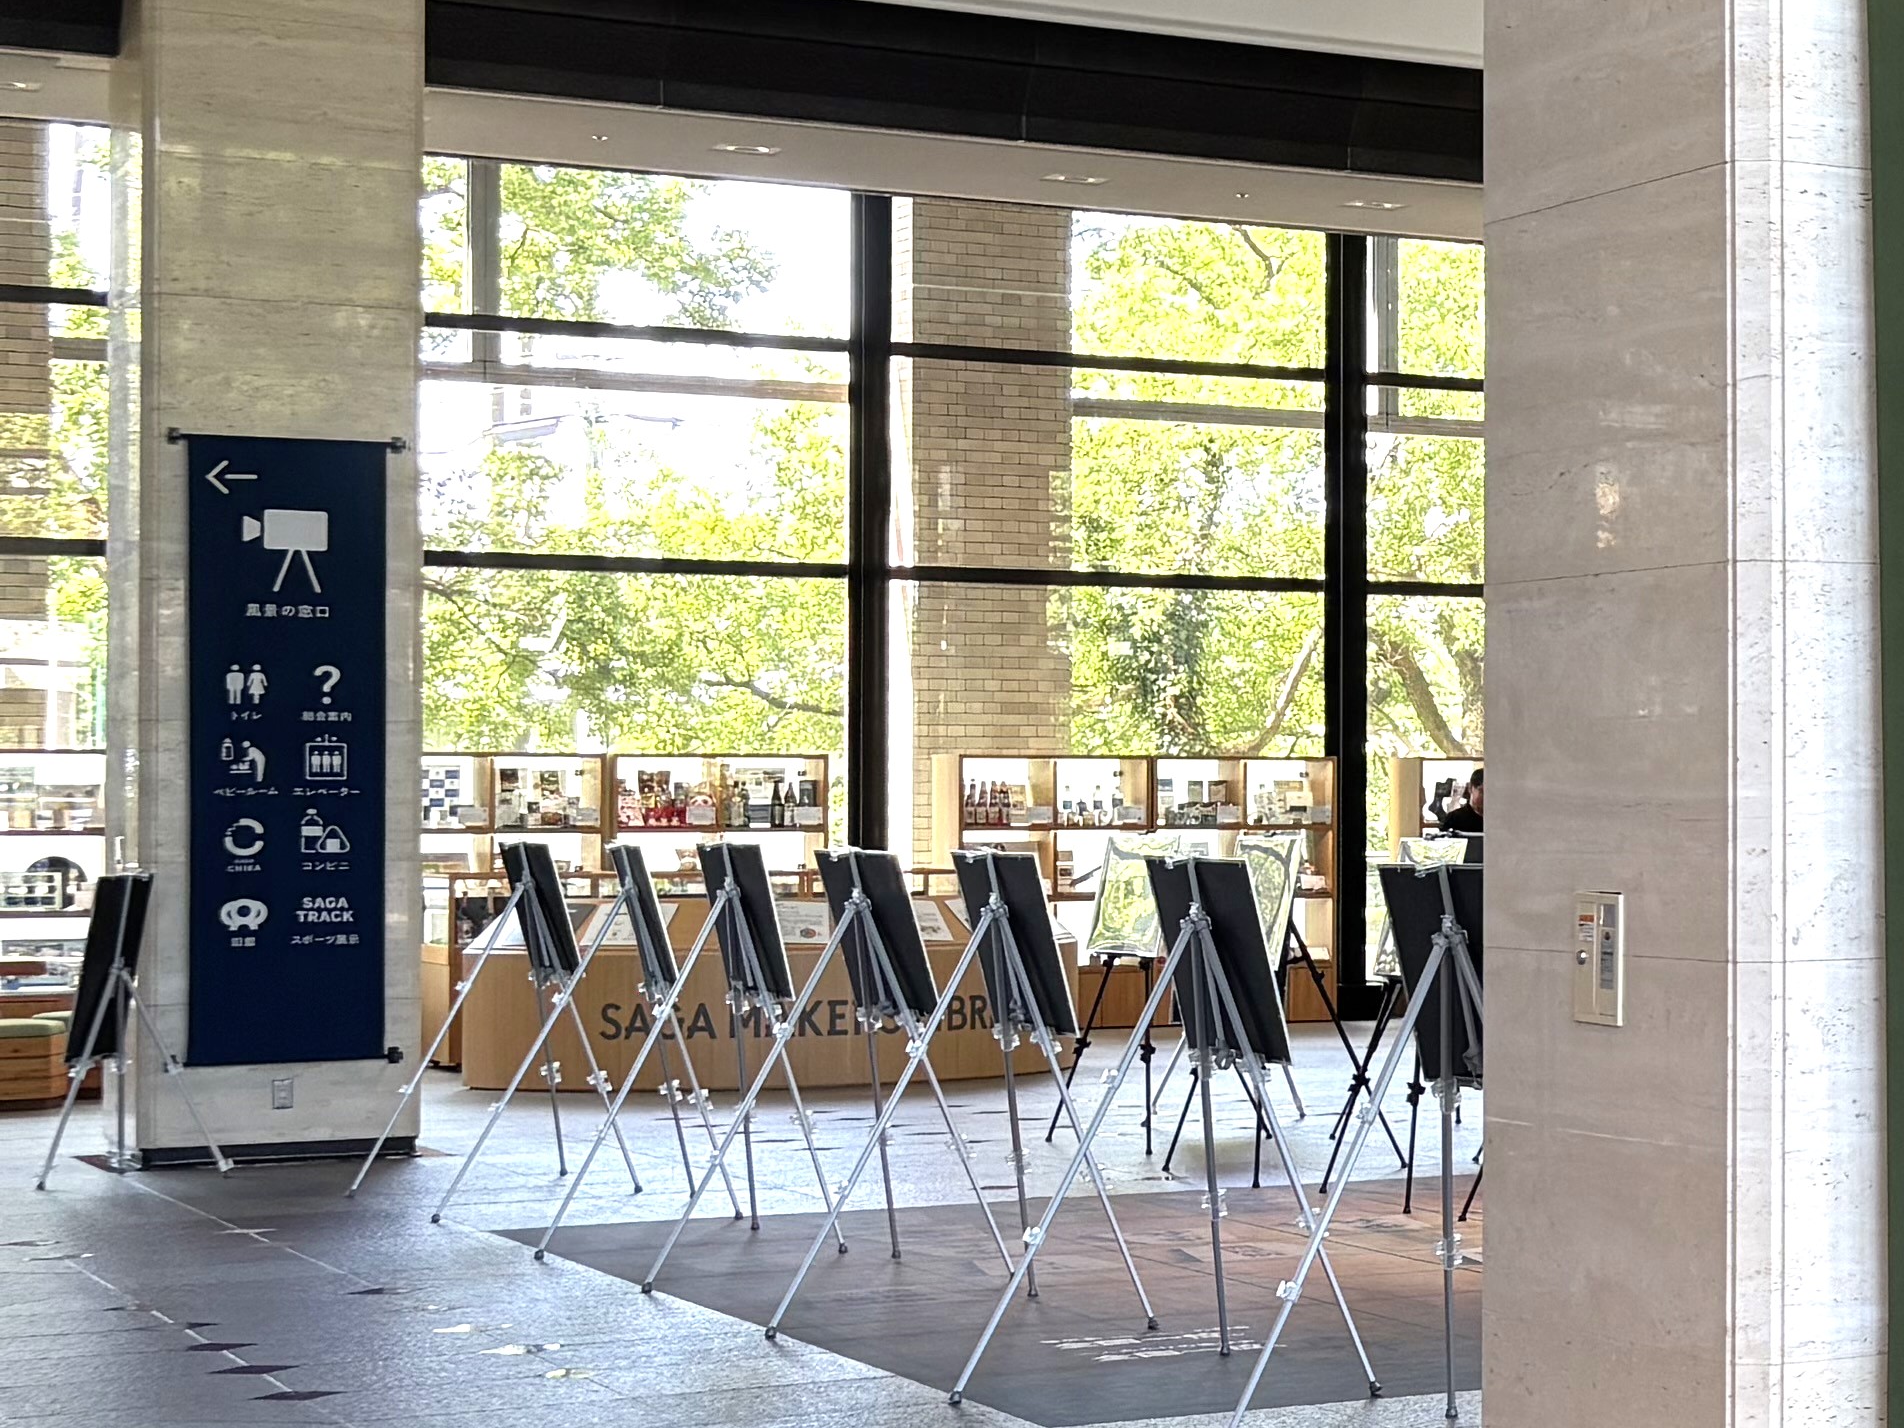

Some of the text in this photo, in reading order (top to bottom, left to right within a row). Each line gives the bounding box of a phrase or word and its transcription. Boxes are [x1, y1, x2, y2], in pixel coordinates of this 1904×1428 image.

[231, 711, 262, 721] トイレ
[302, 862, 350, 871] コンビニ
[302, 897, 349, 909] SAGA
[296, 910, 354, 922] TRACK
